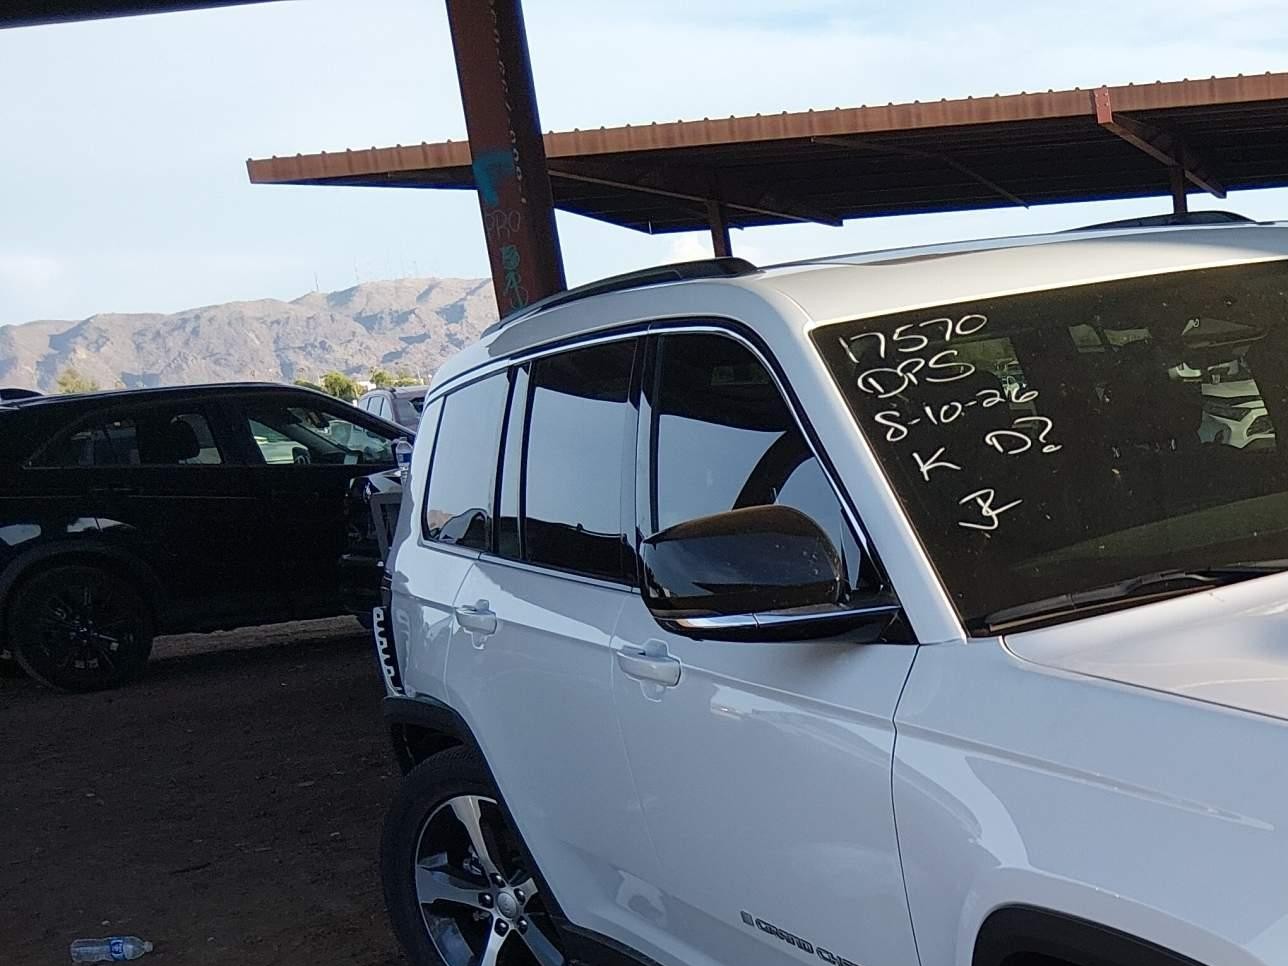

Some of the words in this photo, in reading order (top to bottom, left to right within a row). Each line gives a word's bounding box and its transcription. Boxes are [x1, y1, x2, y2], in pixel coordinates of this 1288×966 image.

[839, 314, 988, 363] 17570
[857, 350, 976, 398] DPS
[874, 388, 1039, 441] 8-10-26
[912, 447, 962, 481] K
[755, 918, 814, 954] GRAND
